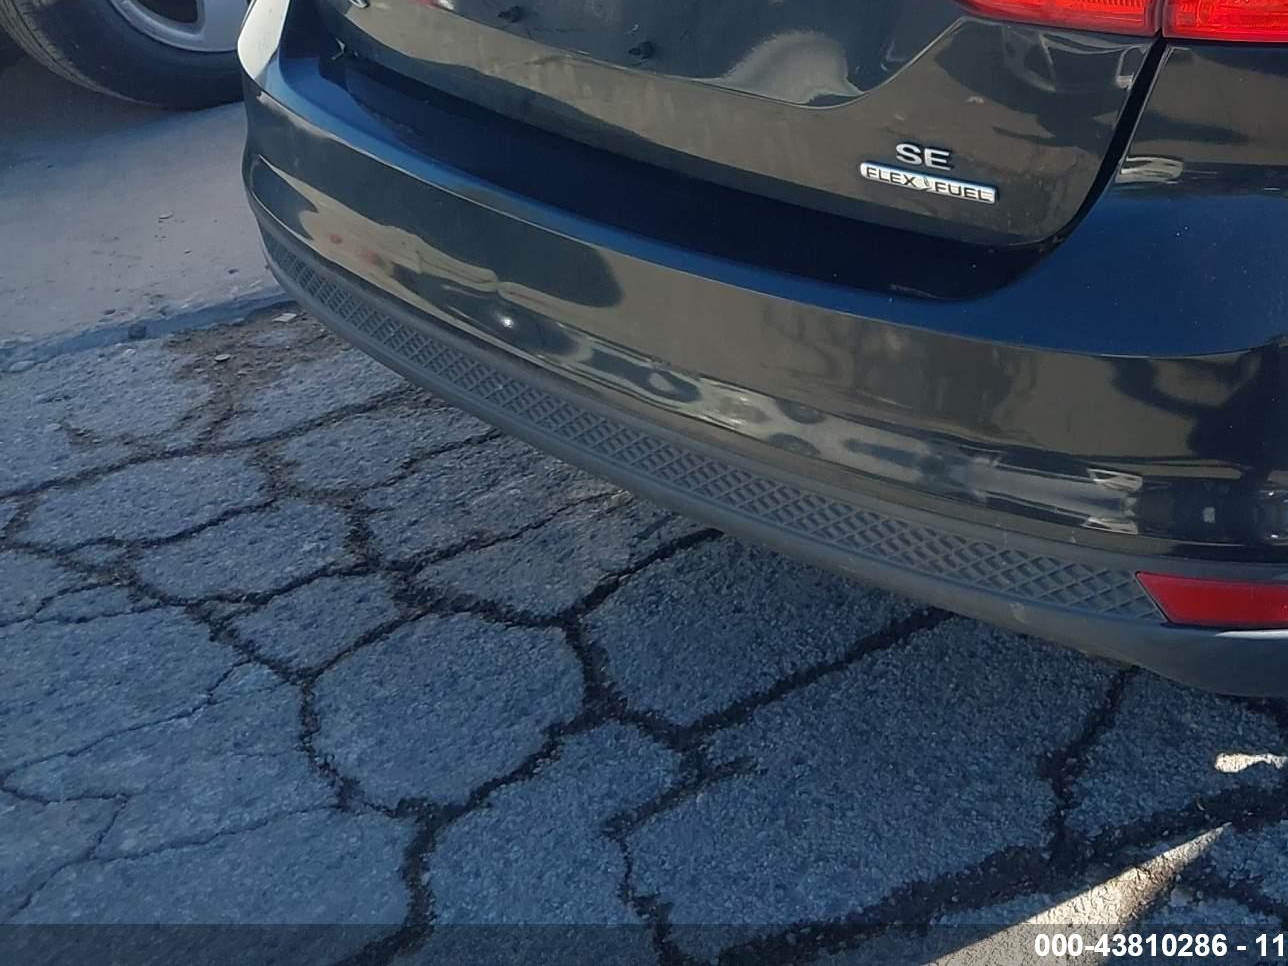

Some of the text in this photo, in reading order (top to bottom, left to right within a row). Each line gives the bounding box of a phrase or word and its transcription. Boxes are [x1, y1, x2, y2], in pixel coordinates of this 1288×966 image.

[895, 143, 951, 170] SE
[865, 166, 994, 202] FLEX FUEL
